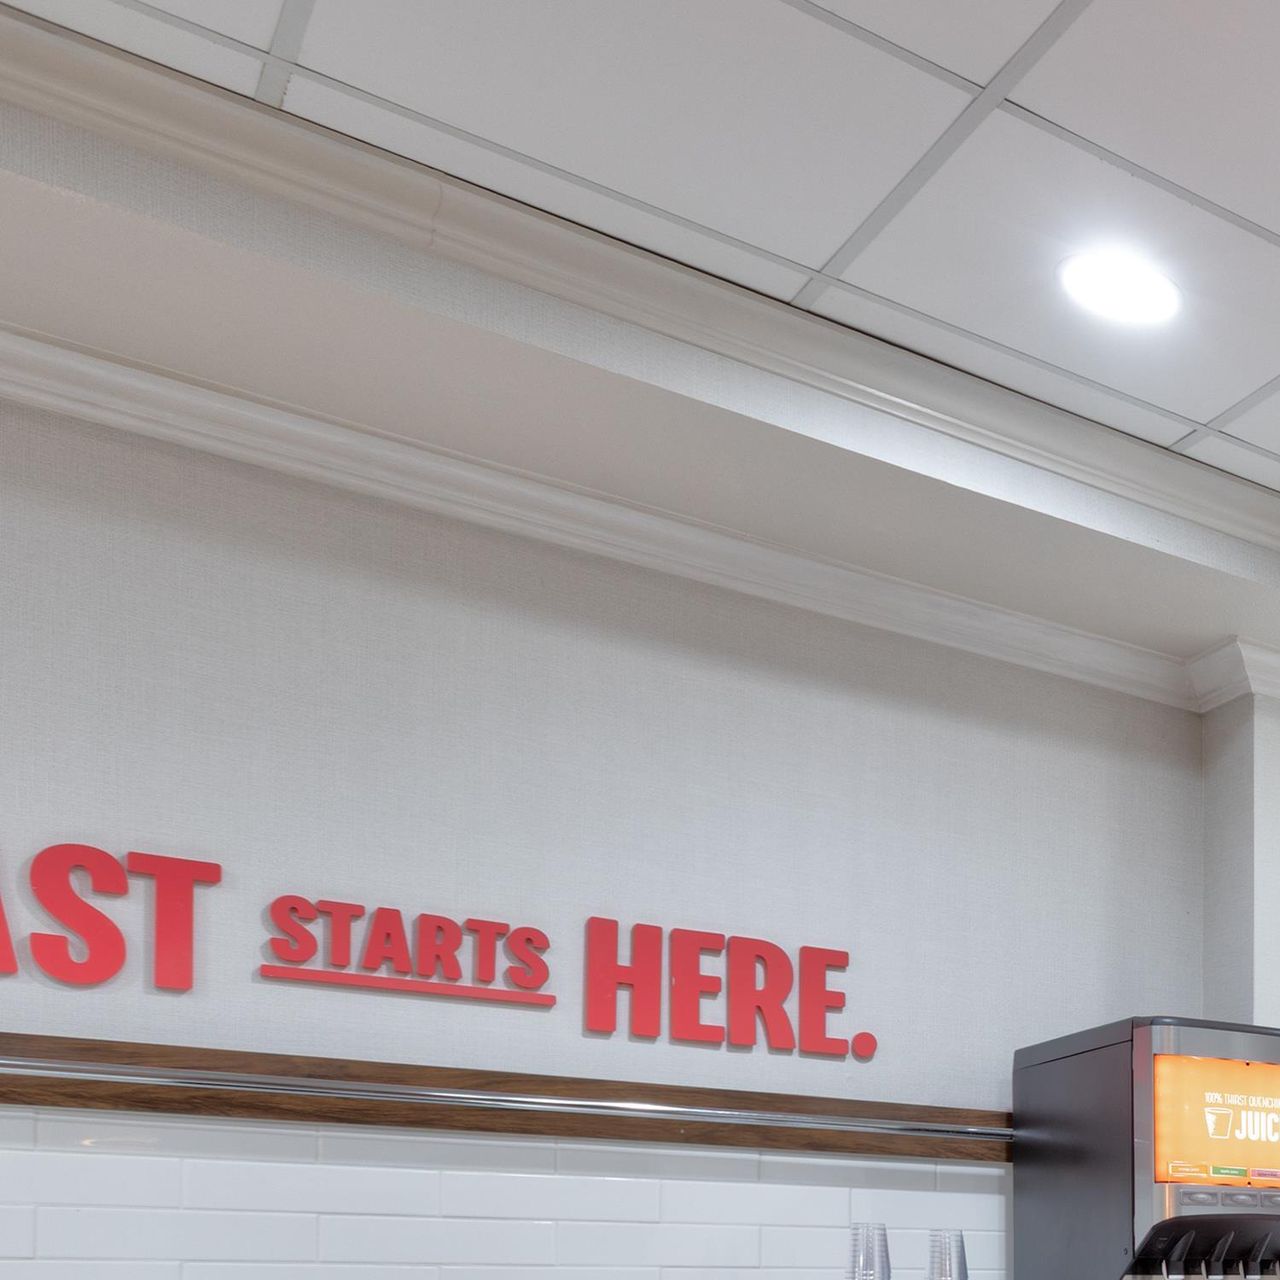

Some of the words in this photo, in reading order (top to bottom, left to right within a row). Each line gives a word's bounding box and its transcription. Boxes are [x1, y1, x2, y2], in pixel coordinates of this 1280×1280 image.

[0, 843, 222, 991] ST
[269, 894, 551, 989] STARTS
[586, 916, 878, 1060] HERE.
[1224, 1093, 1247, 1106] THIRST
